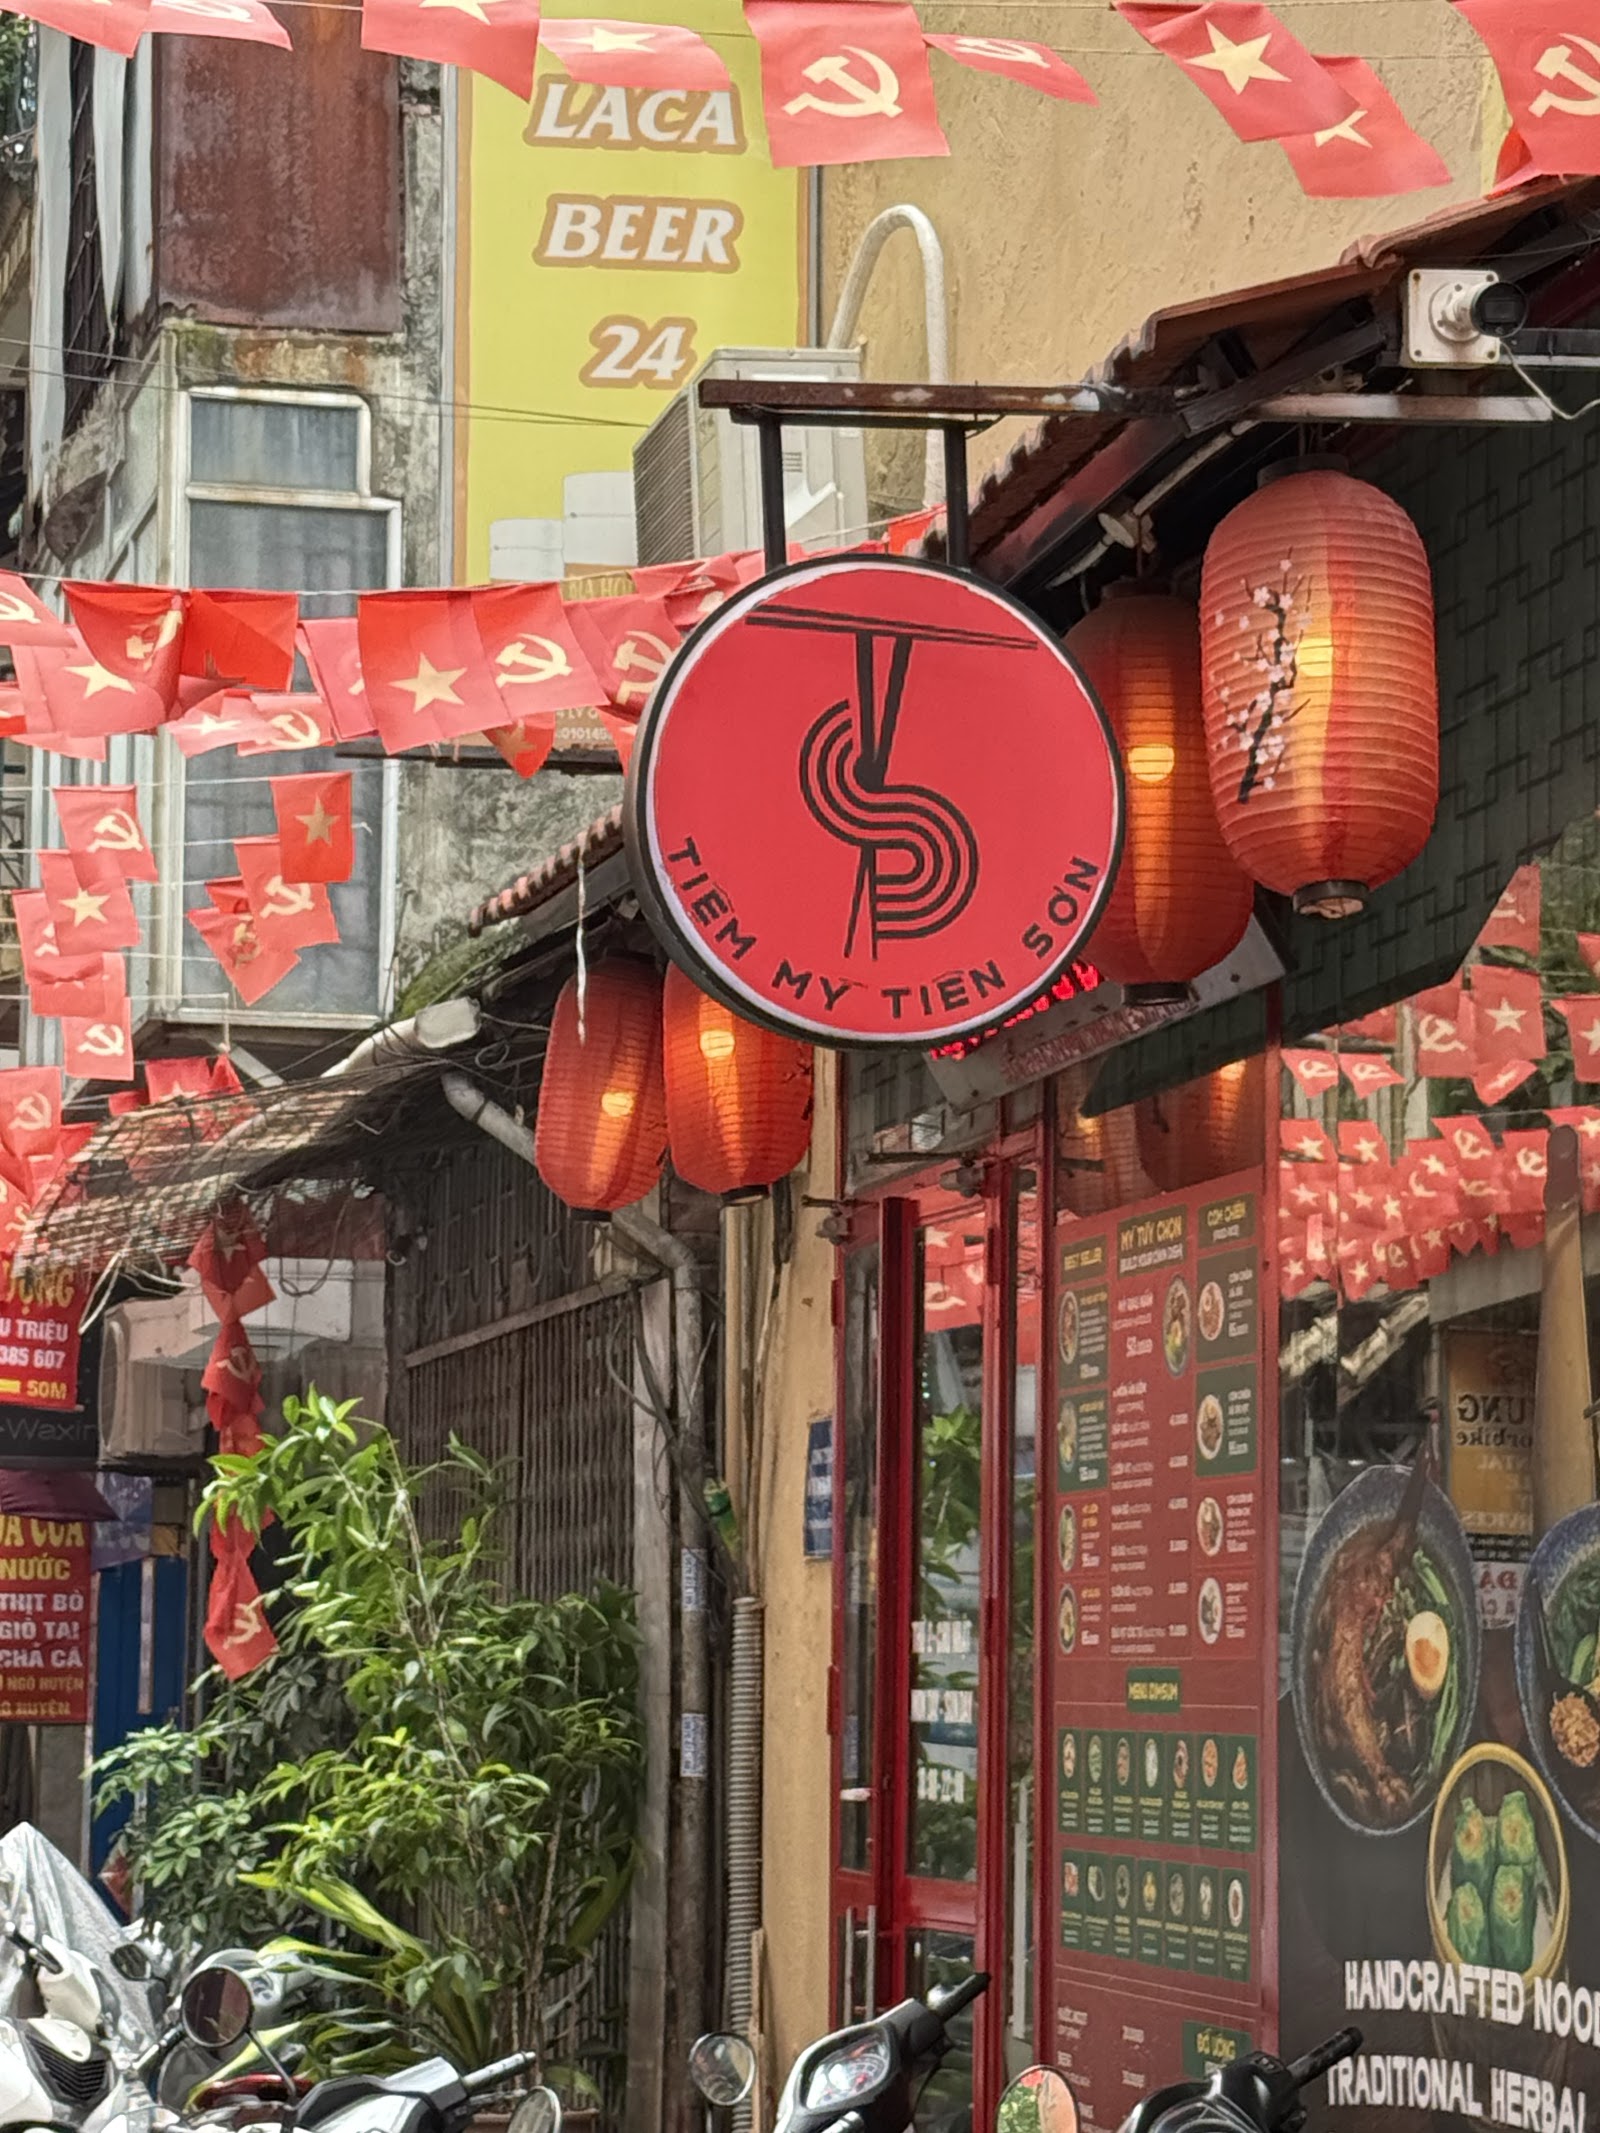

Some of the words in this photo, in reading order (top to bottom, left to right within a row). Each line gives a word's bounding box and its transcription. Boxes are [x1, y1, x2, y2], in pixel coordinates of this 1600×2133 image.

[535, 81, 738, 146] LACA
[543, 203, 735, 264] BEER
[589, 324, 687, 381] 24
[1021, 856, 1099, 959] SƠN
[16, 1319, 68, 1345] TRIỆU
[33, 1349, 65, 1369] 607
[0, 1552, 71, 1581] NƯỚC
[1345, 1960, 1525, 2026] HANDCRAFTED
[1328, 2054, 1483, 2117] TRADITIONAL
